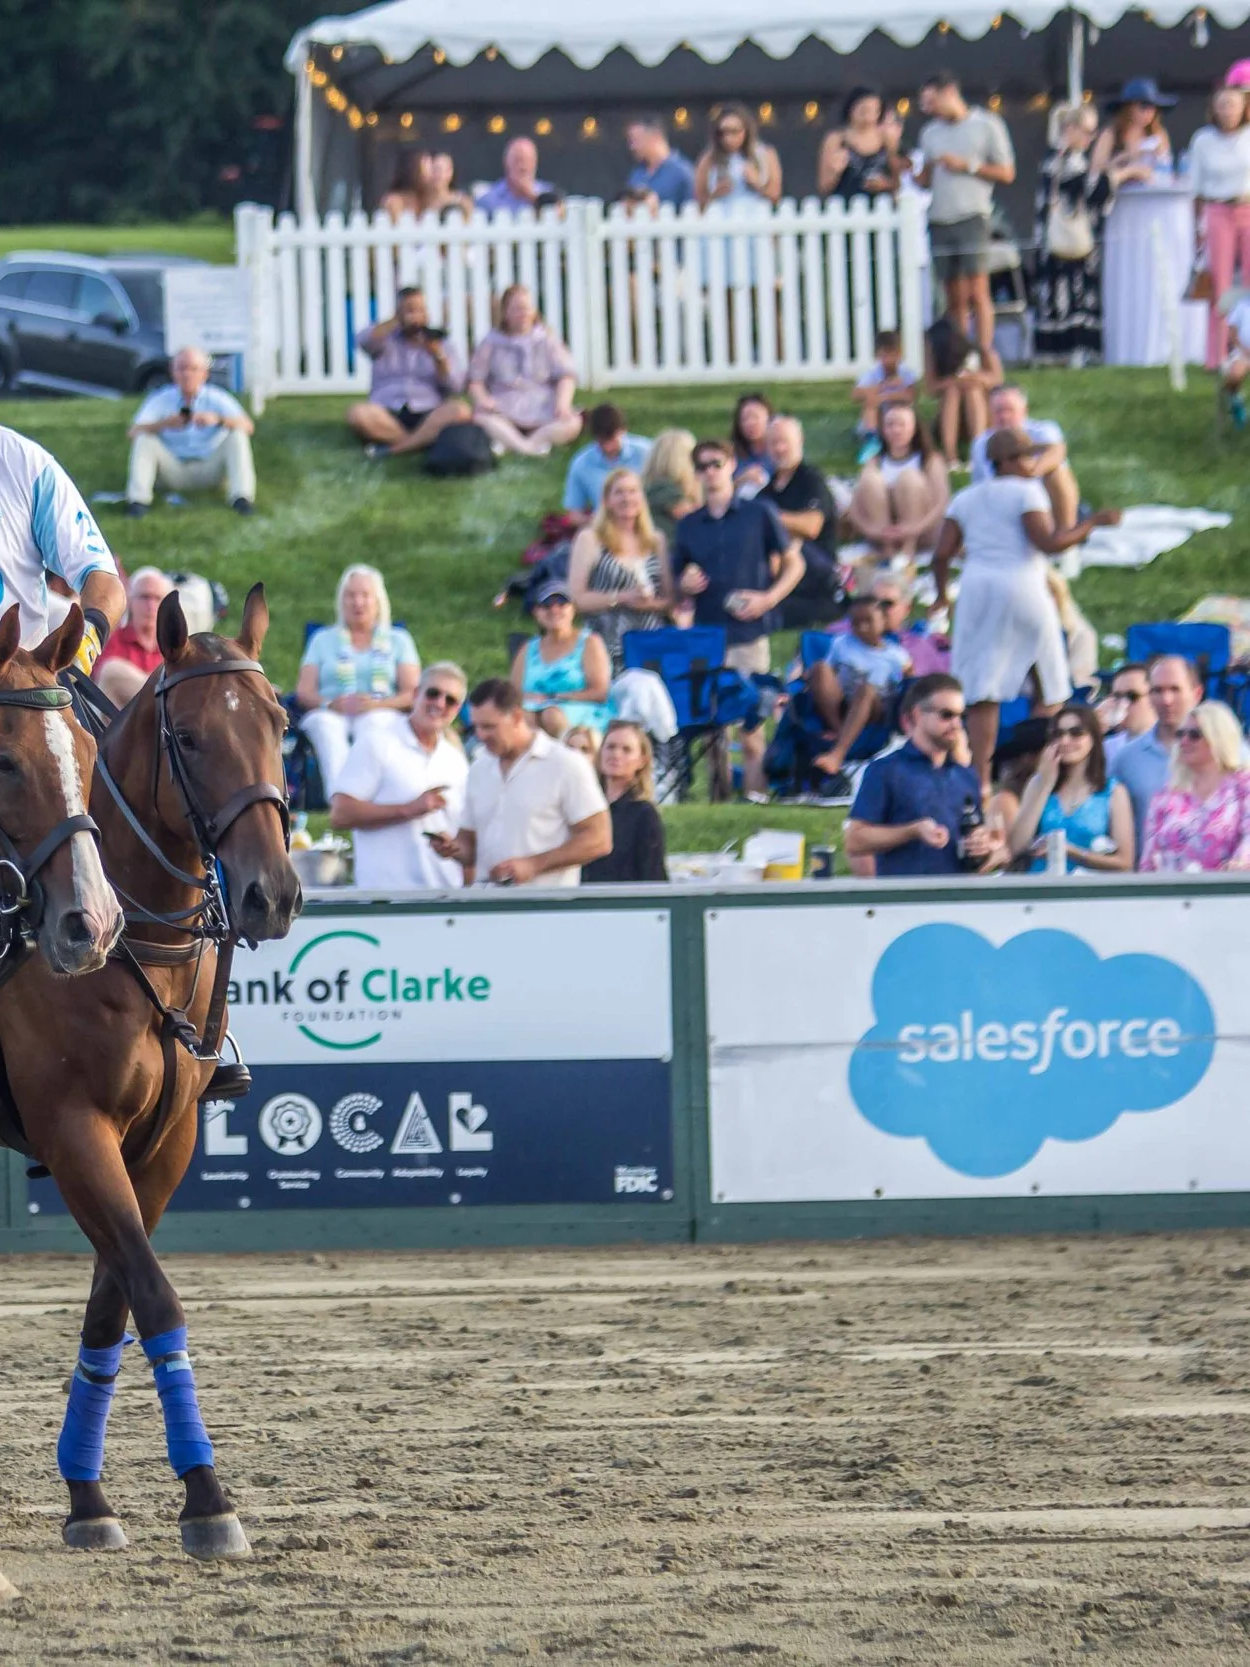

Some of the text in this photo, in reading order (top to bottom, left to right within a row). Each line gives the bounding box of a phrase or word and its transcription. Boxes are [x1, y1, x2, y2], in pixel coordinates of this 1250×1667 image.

[306, 968, 350, 1004] of
[361, 967, 492, 1004] Clarke
[280, 1009, 404, 1022] FOUNDATION
[896, 1007, 1183, 1076] salesforce
[613, 1175, 659, 1193] FDIC
